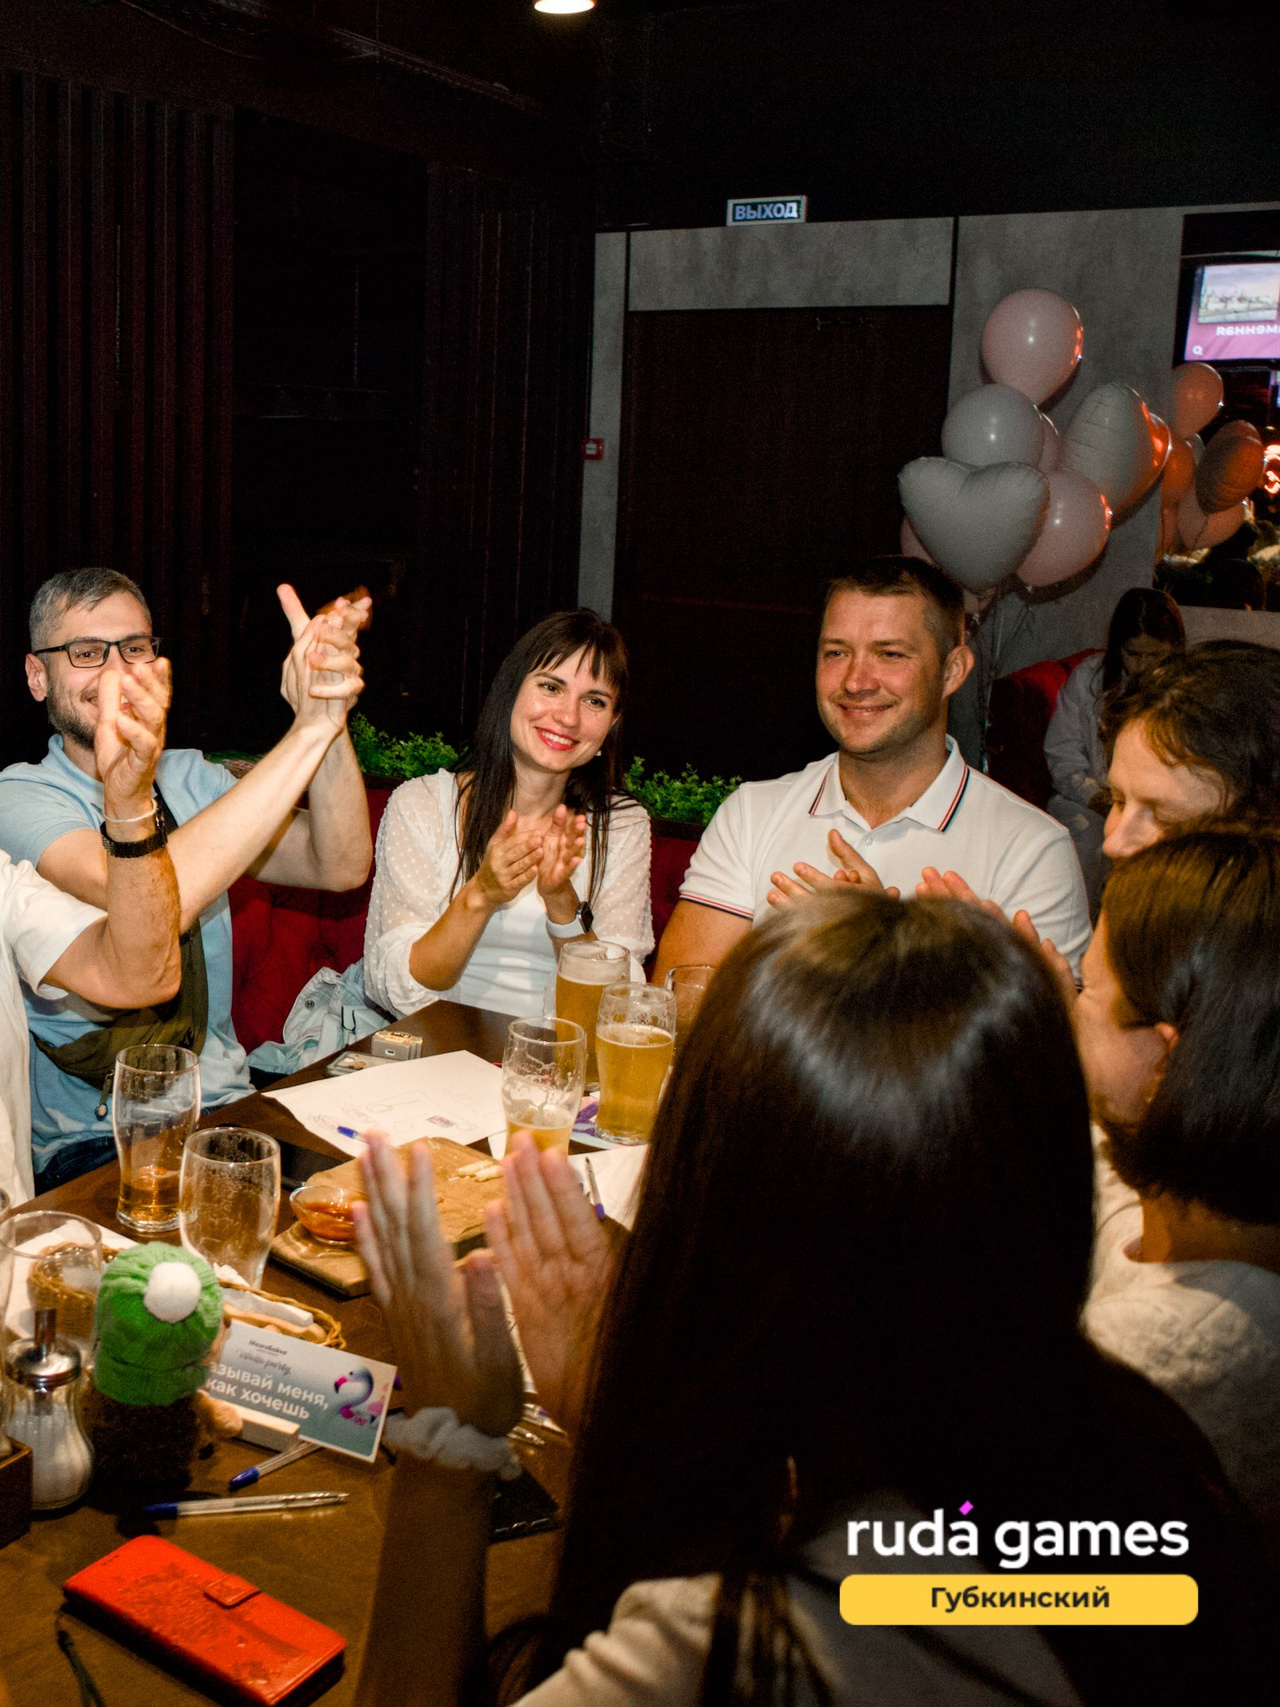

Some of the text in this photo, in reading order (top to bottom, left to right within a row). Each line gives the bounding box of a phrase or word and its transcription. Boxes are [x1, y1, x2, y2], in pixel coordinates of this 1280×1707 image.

[734, 202, 798, 220] ВЫХОД
[206, 1378, 310, 1420] как хочешь
[209, 1361, 329, 1411] азывай меня,
